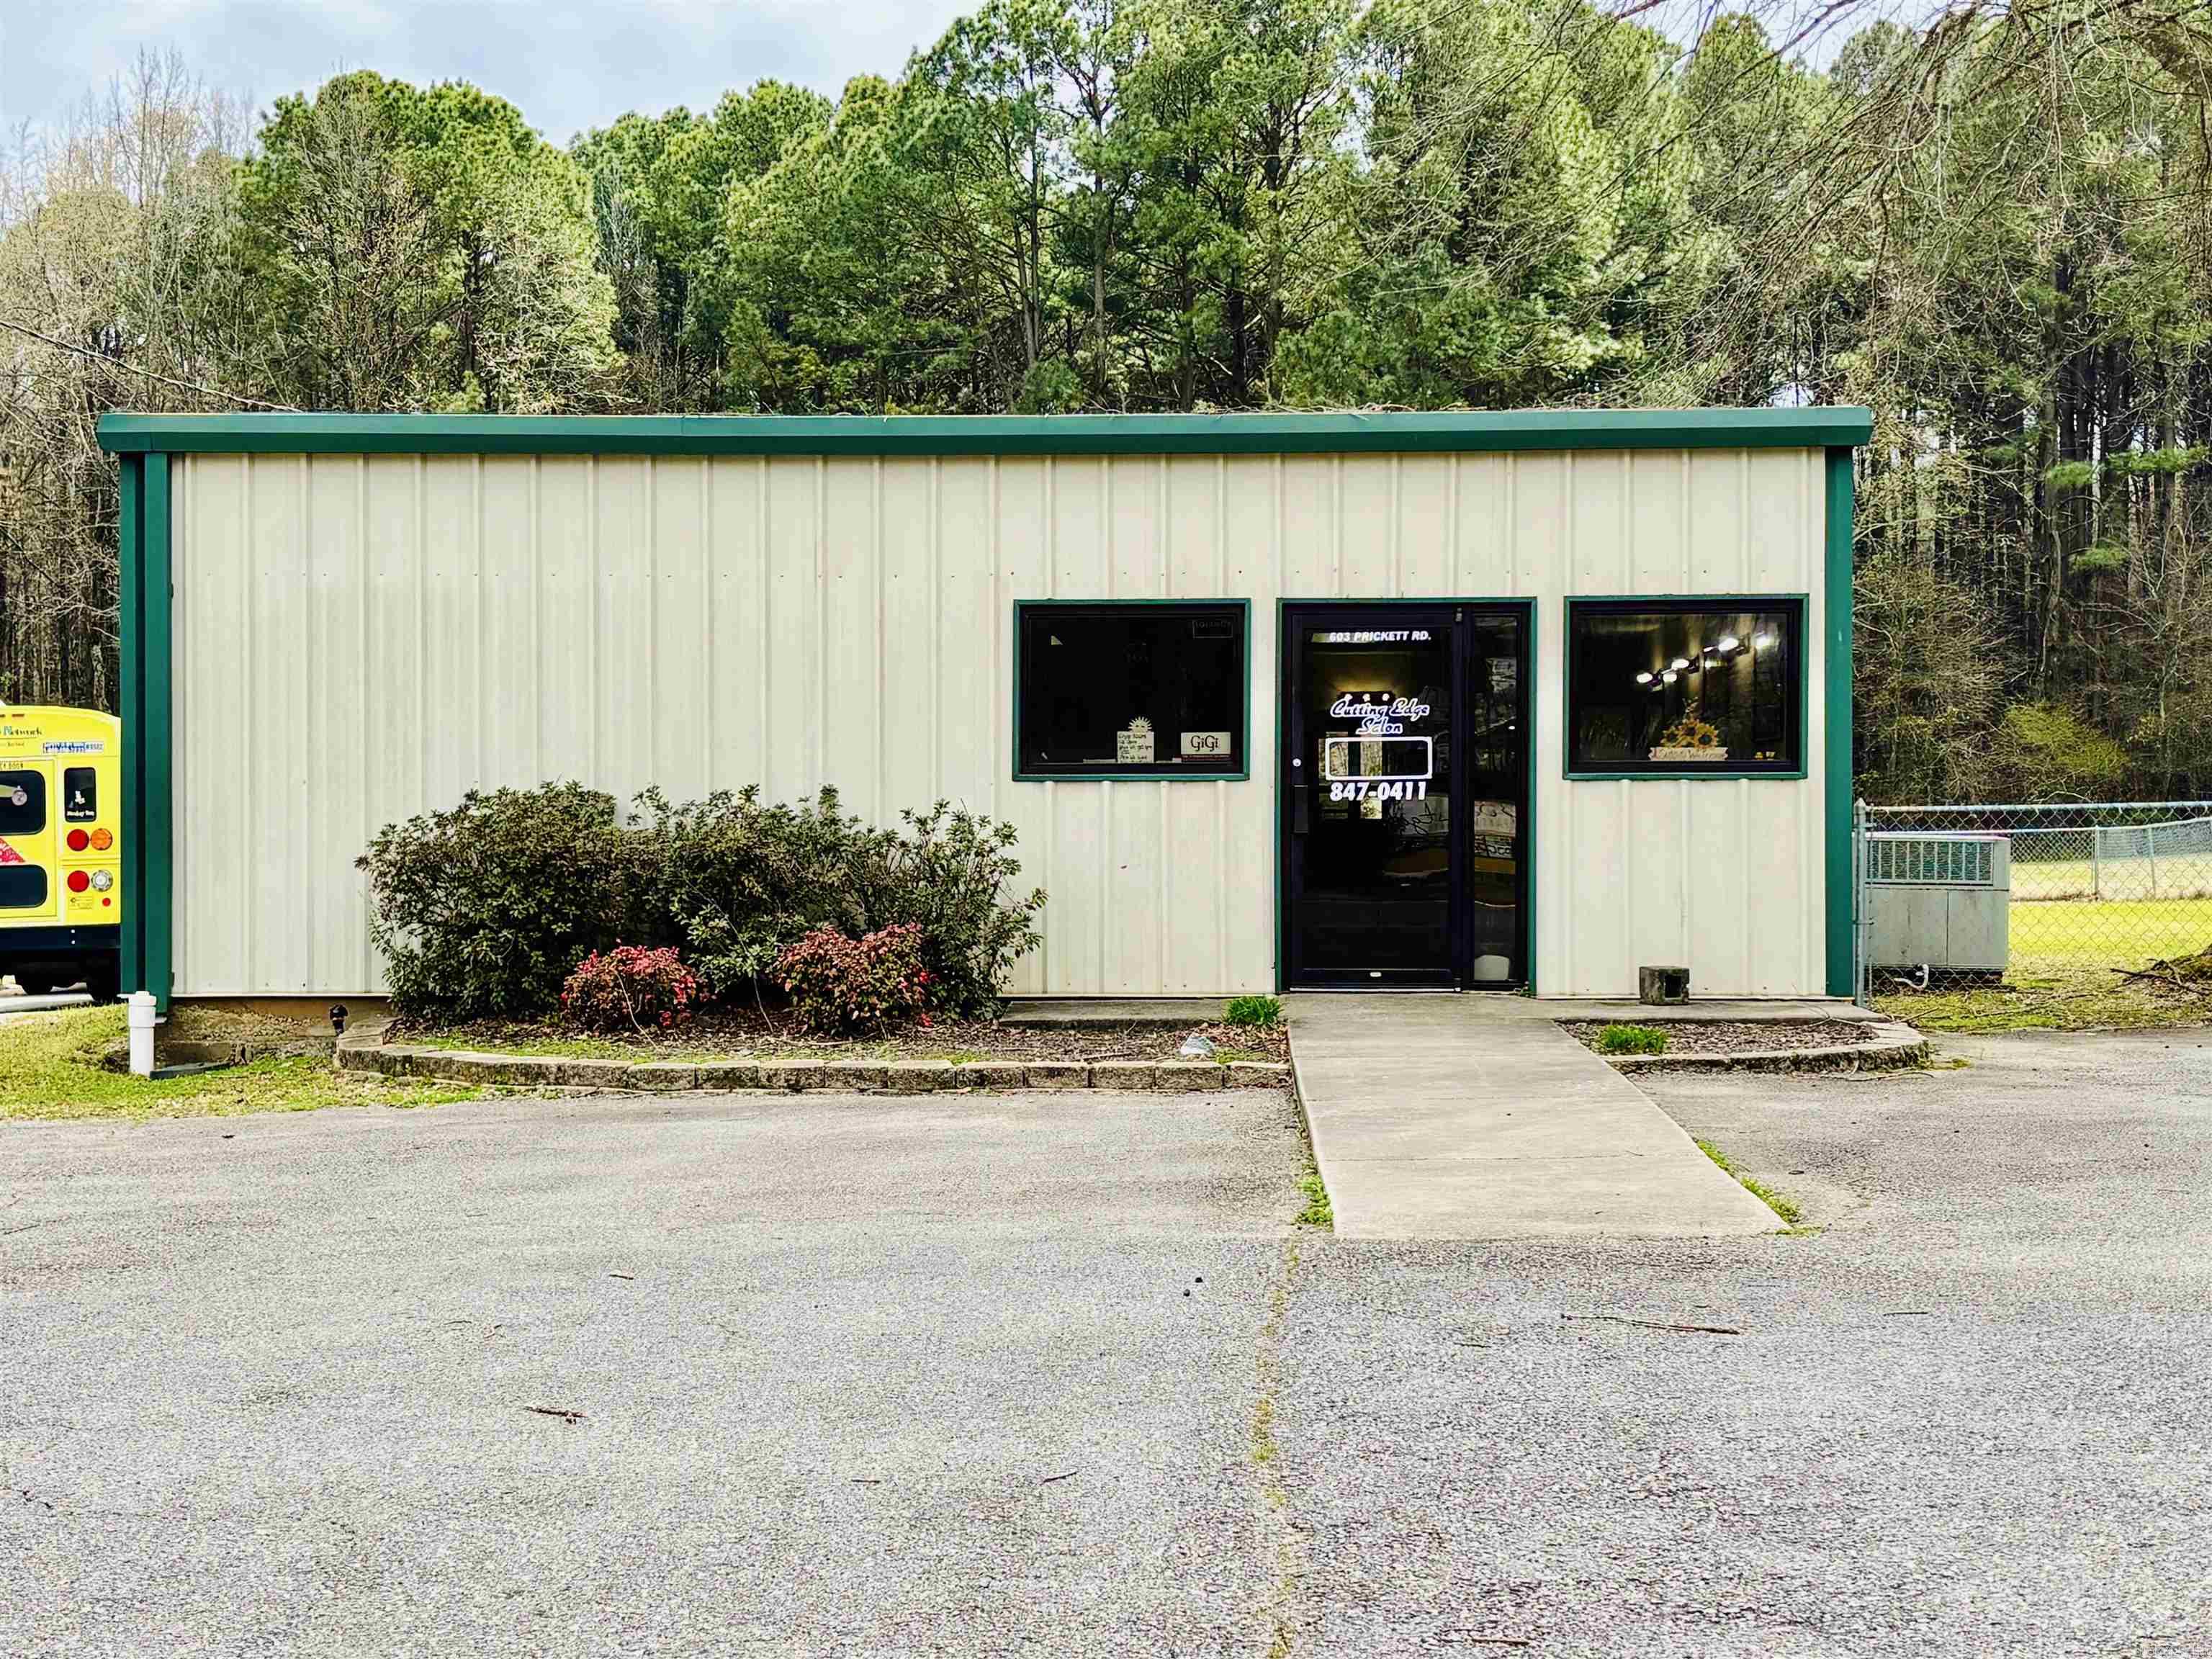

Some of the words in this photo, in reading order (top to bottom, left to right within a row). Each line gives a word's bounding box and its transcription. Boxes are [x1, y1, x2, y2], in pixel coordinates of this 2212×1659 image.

[1329, 631, 1351, 642] 603
[1354, 631, 1409, 642] PRICKETT
[1411, 631, 1431, 641] RD.
[1330, 699, 1388, 721] Cutting
[1390, 698, 1430, 721] Edge
[1356, 717, 1403, 734] Salon
[1190, 735, 1218, 752] GiGi
[1330, 781, 1426, 801] 847-0411
